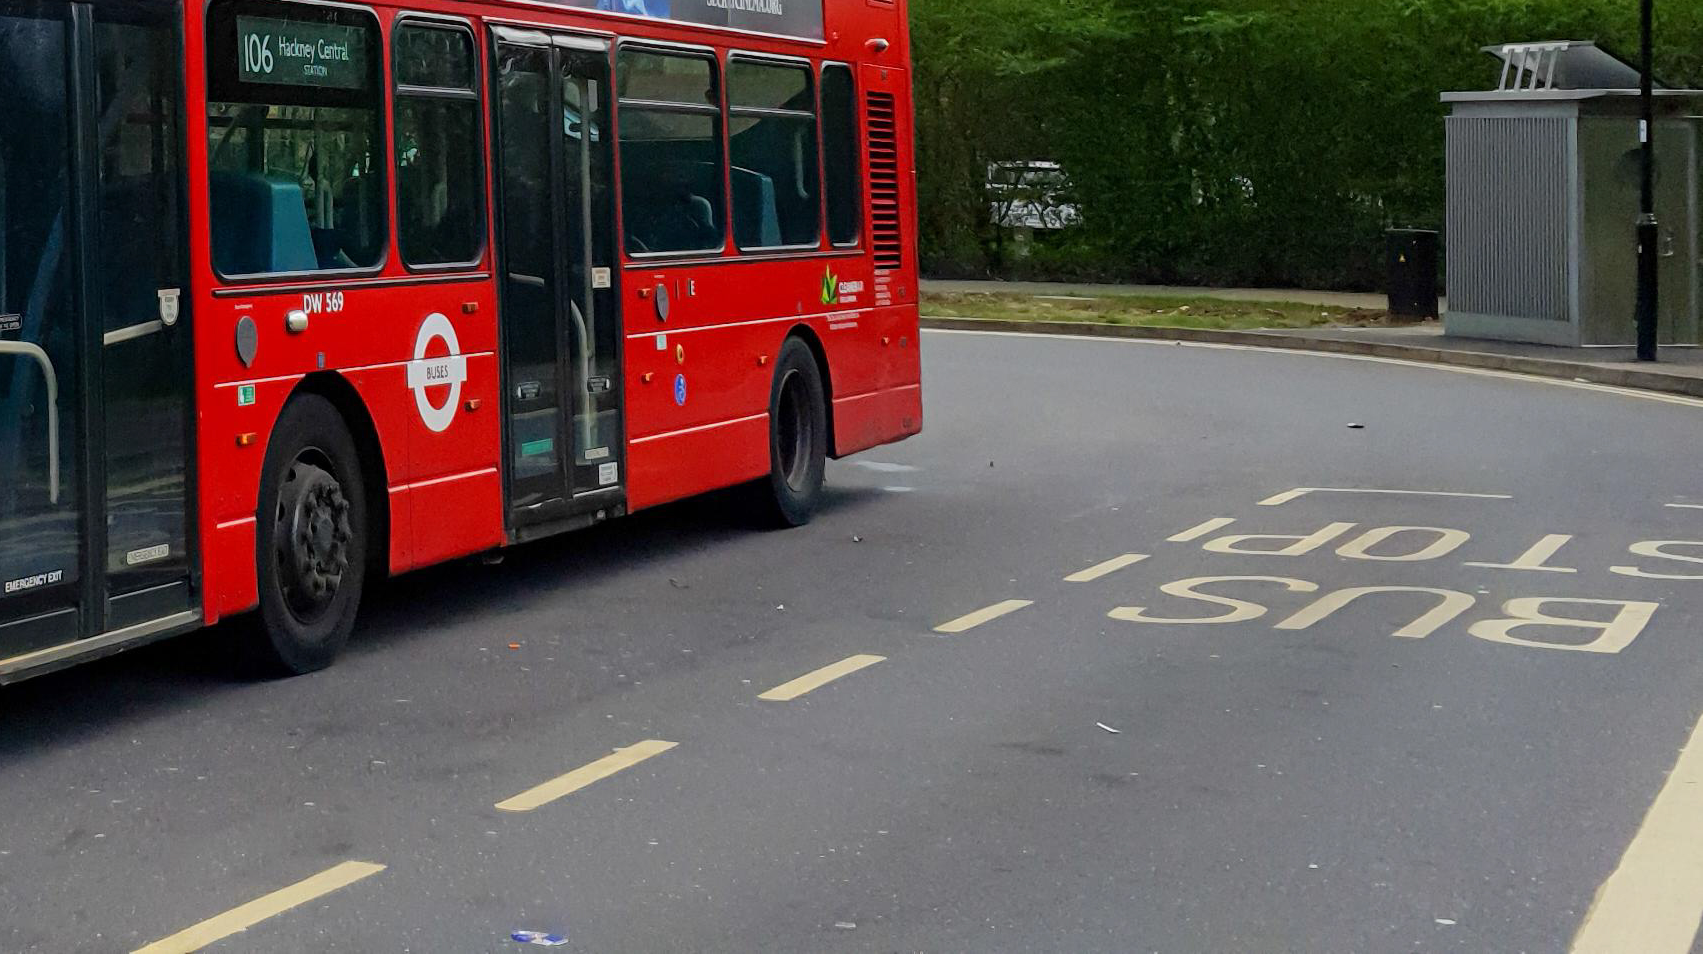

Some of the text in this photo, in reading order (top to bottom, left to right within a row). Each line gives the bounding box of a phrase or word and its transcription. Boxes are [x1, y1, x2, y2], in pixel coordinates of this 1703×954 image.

[245, 34, 349, 73] 106 Hackney Central
[304, 65, 327, 77] STATION
[303, 291, 344, 314] DW 569
[427, 365, 448, 380] BUSES
[5, 570, 63, 593] EMERGENCY EXIT
[1107, 575, 1659, 653] BUS
